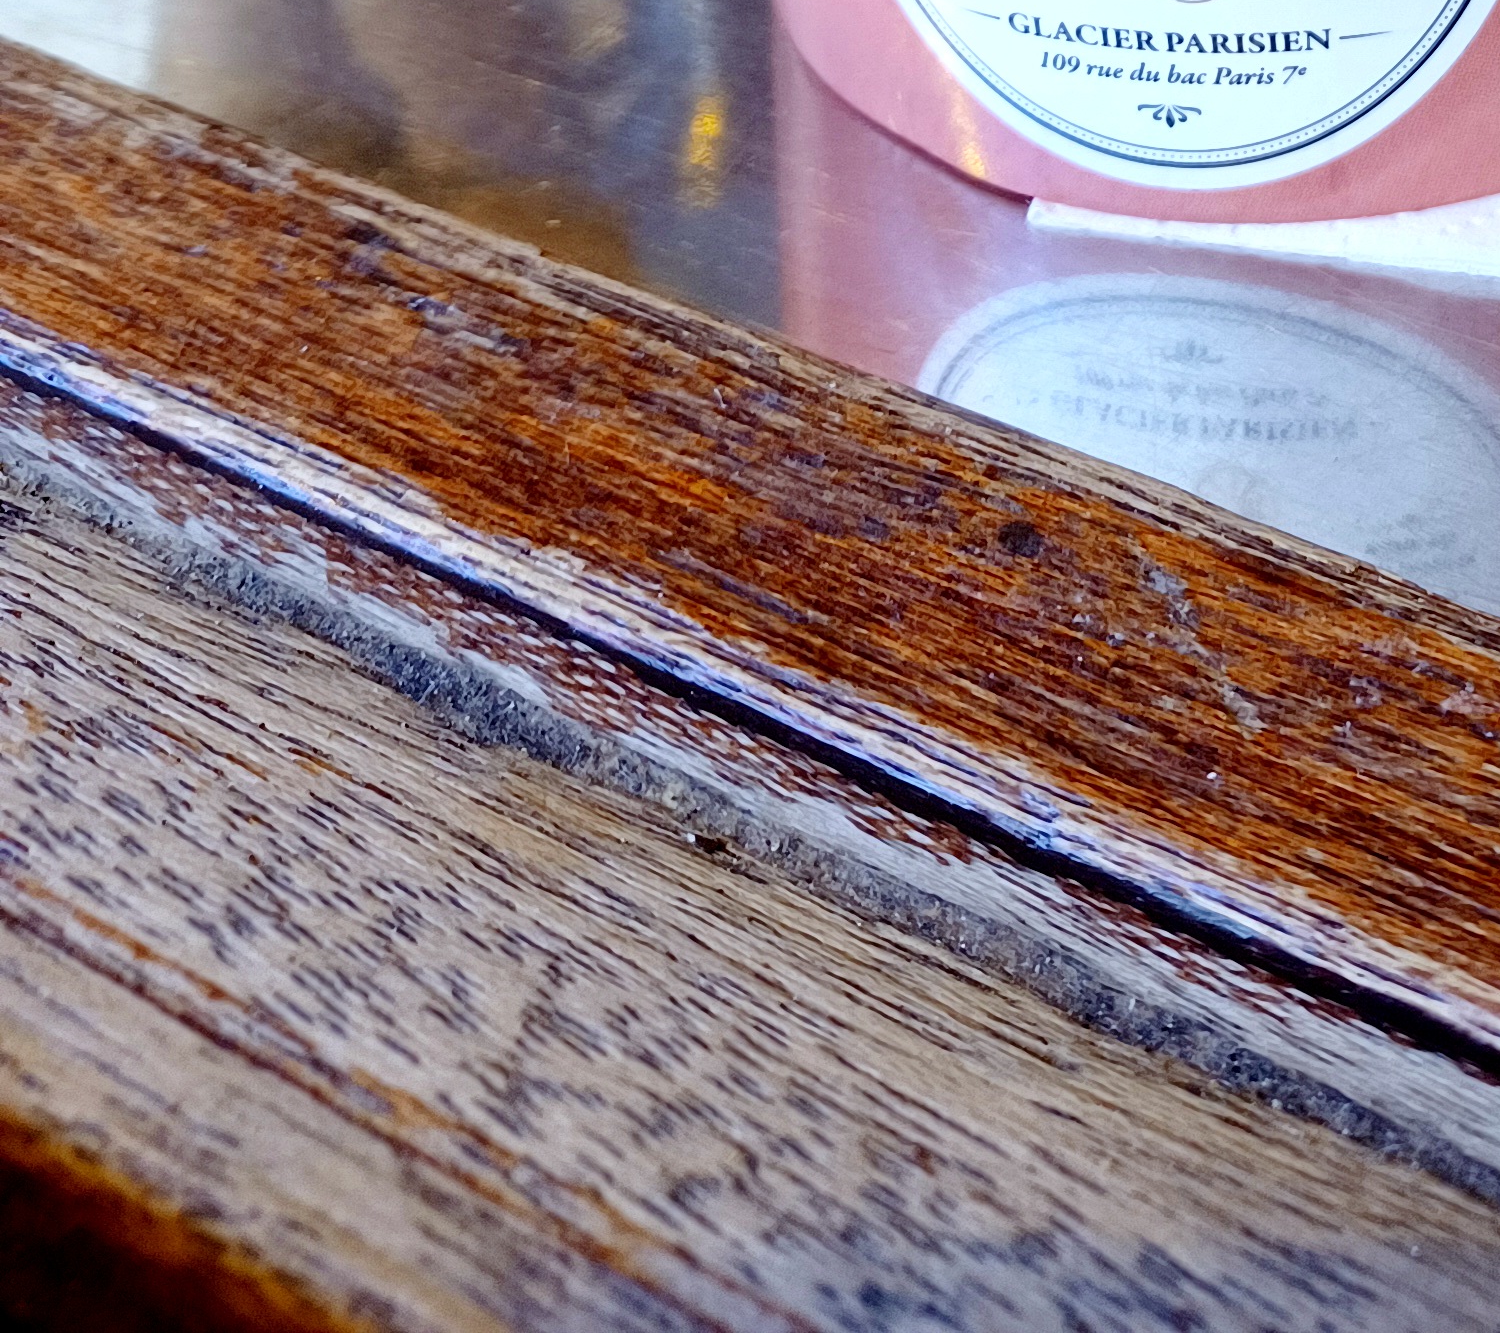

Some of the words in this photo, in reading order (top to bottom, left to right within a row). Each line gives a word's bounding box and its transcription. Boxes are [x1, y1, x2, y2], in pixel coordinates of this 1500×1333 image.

[1007, 12, 1160, 52] GLACIER
[1164, 28, 1332, 54] PARISIEN
[1041, 51, 1081, 74] 109
[1086, 61, 1125, 79] rue
[1129, 61, 1161, 83] du
[1166, 63, 1208, 85] bac
[1212, 66, 1275, 85] Paris
